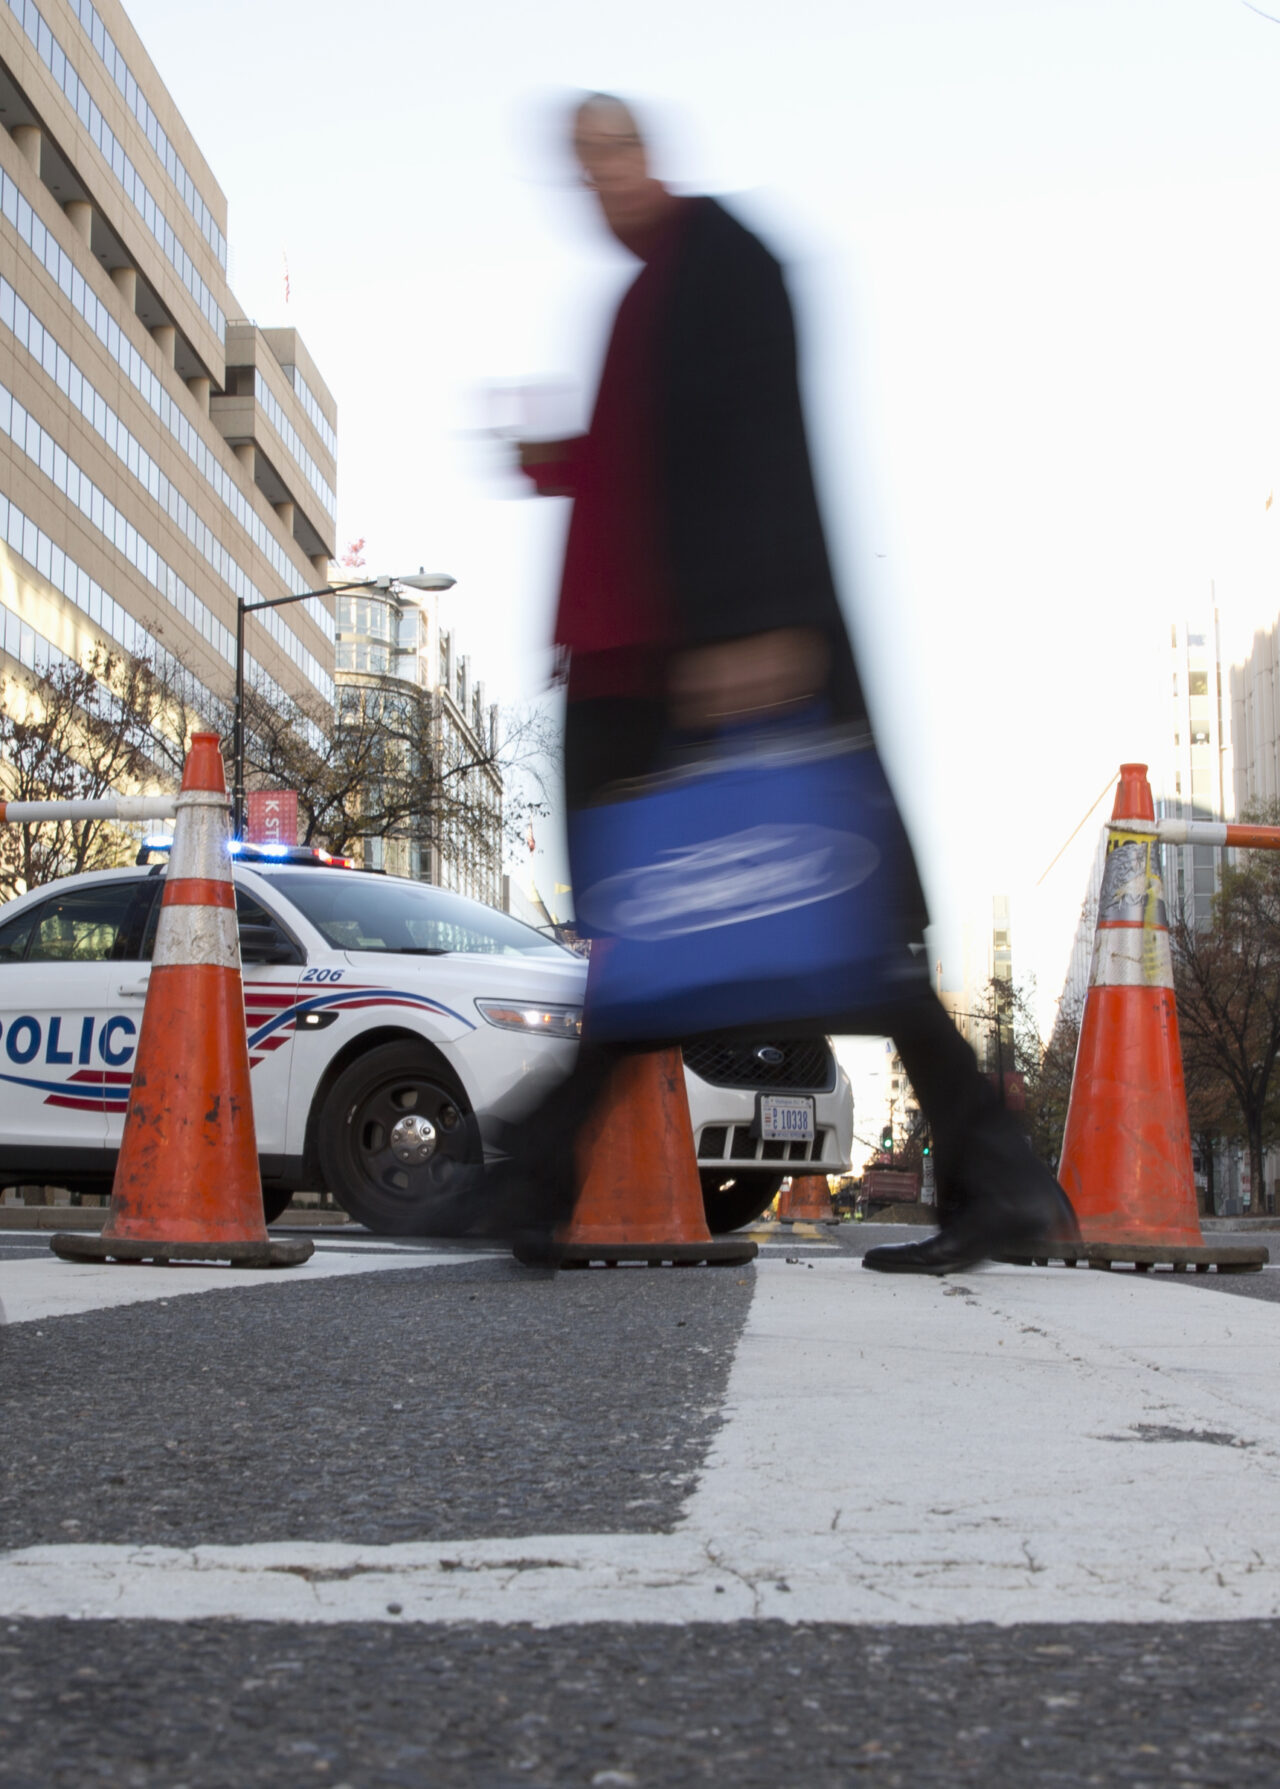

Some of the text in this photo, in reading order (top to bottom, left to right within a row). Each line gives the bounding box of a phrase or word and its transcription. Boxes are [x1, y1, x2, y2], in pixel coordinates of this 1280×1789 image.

[265, 801, 279, 812] K
[302, 968, 345, 982] 206
[781, 1110, 808, 1130] 10338
